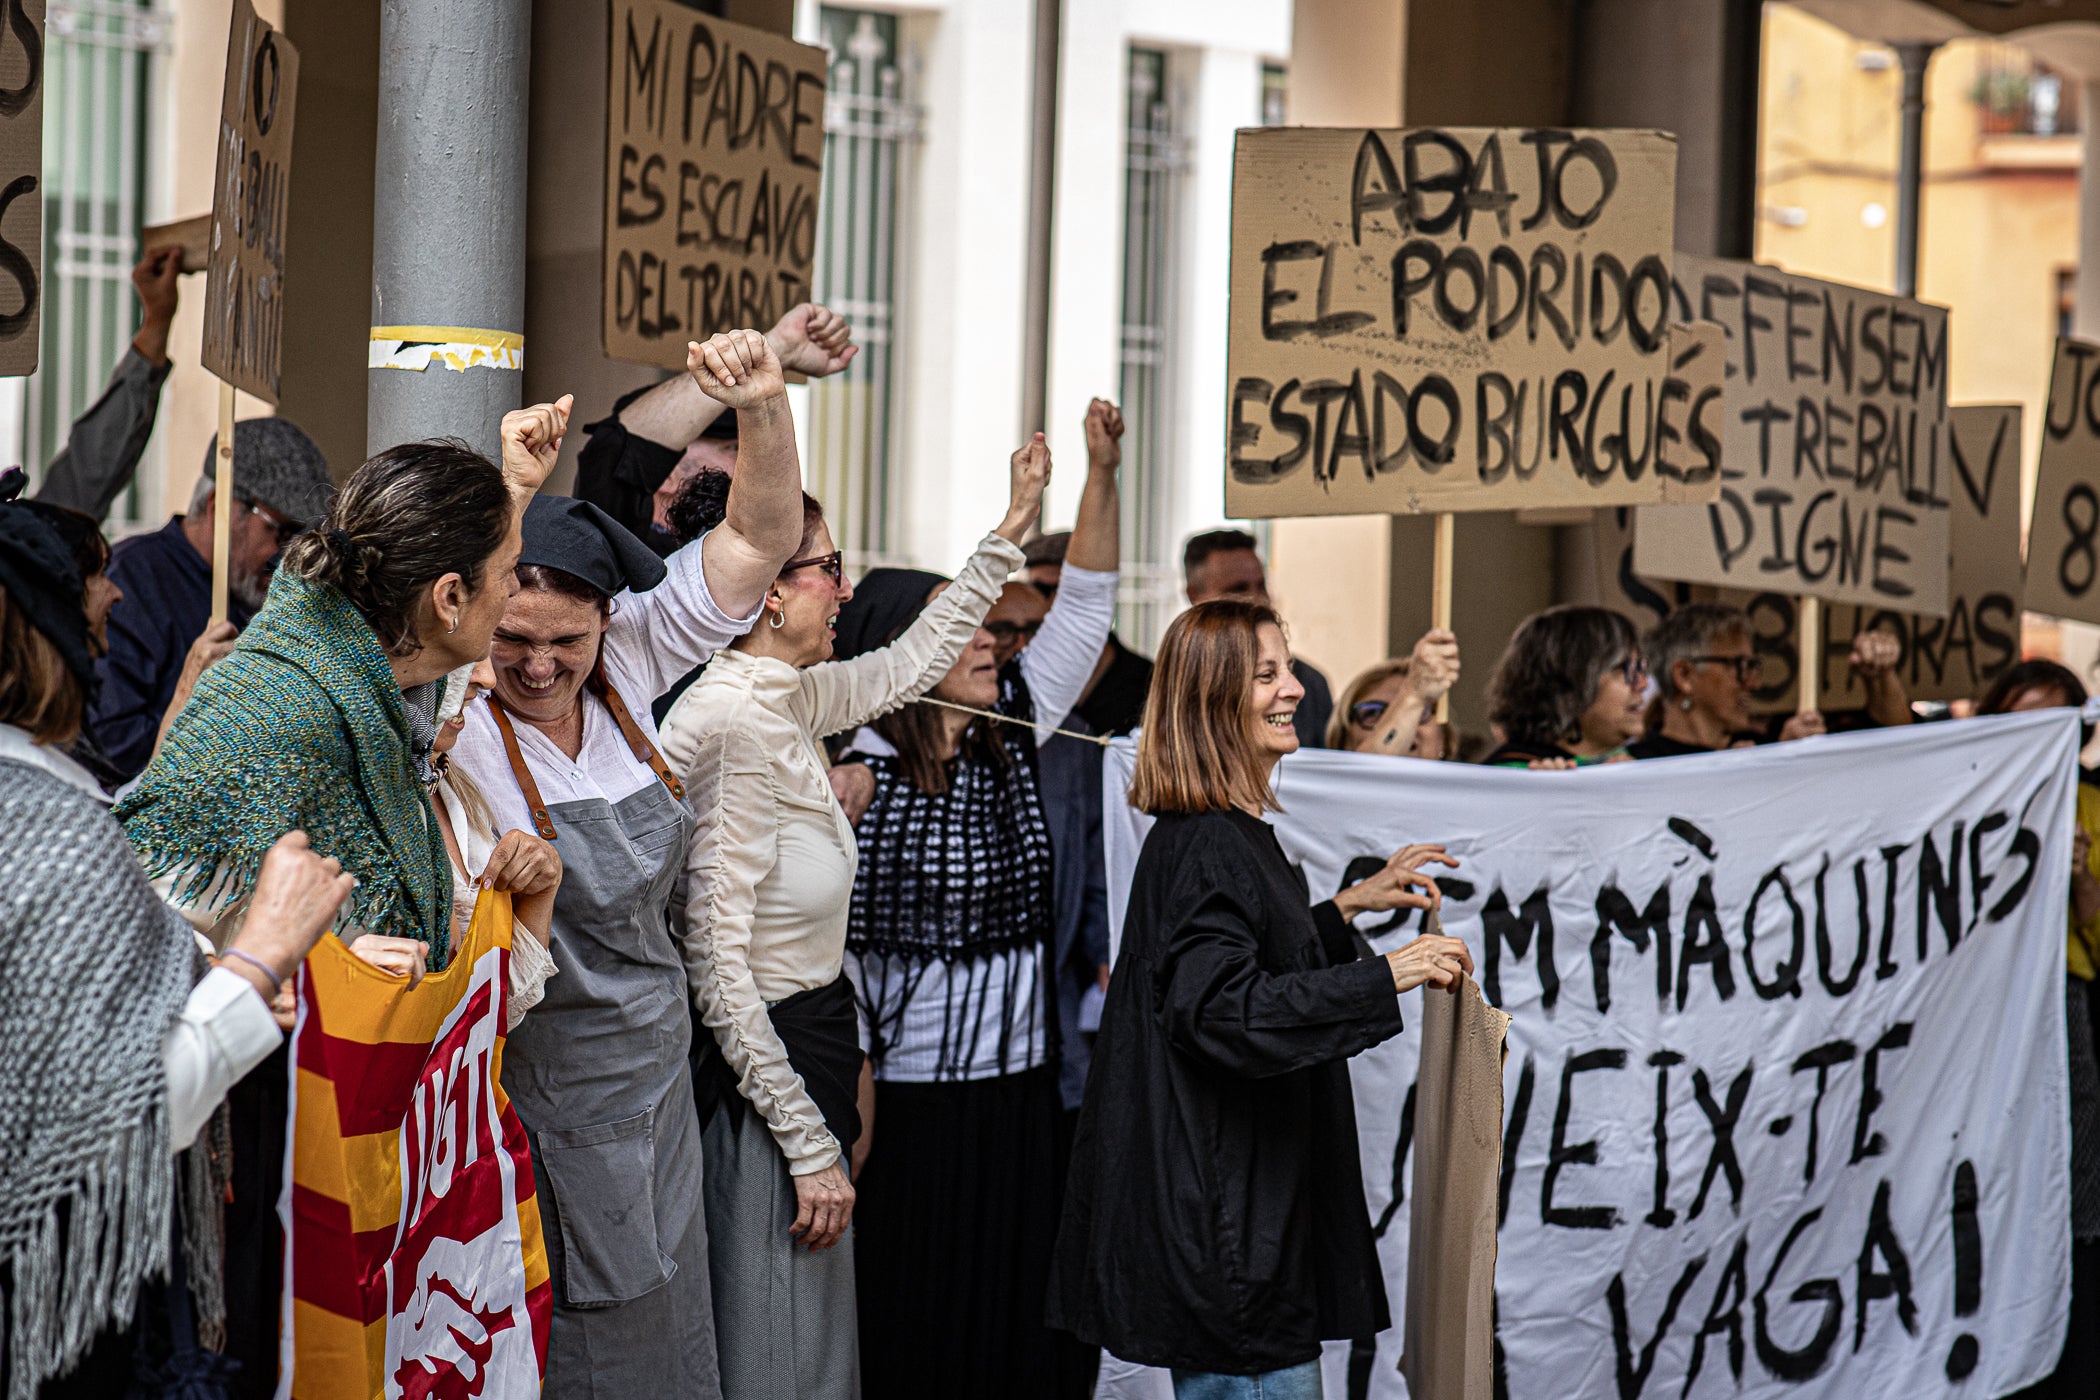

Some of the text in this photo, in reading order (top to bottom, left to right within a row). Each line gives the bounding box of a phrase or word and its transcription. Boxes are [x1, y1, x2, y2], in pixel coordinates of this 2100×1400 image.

[623, 8, 826, 172] MI PADRE
[617, 143, 816, 270] ES ESCLAVO
[1351, 128, 1618, 245] ABAJO
[615, 248, 681, 339] DEL
[1261, 238, 1670, 355] EL PODRIDO
[1231, 340, 1723, 494] ESTADO BURGUÉS
[1741, 394, 1951, 510] TREBALL
[1707, 487, 1918, 597] DIGNE
[2059, 482, 2100, 598] 8
[1590, 780, 2052, 1014] MÀQUINES
